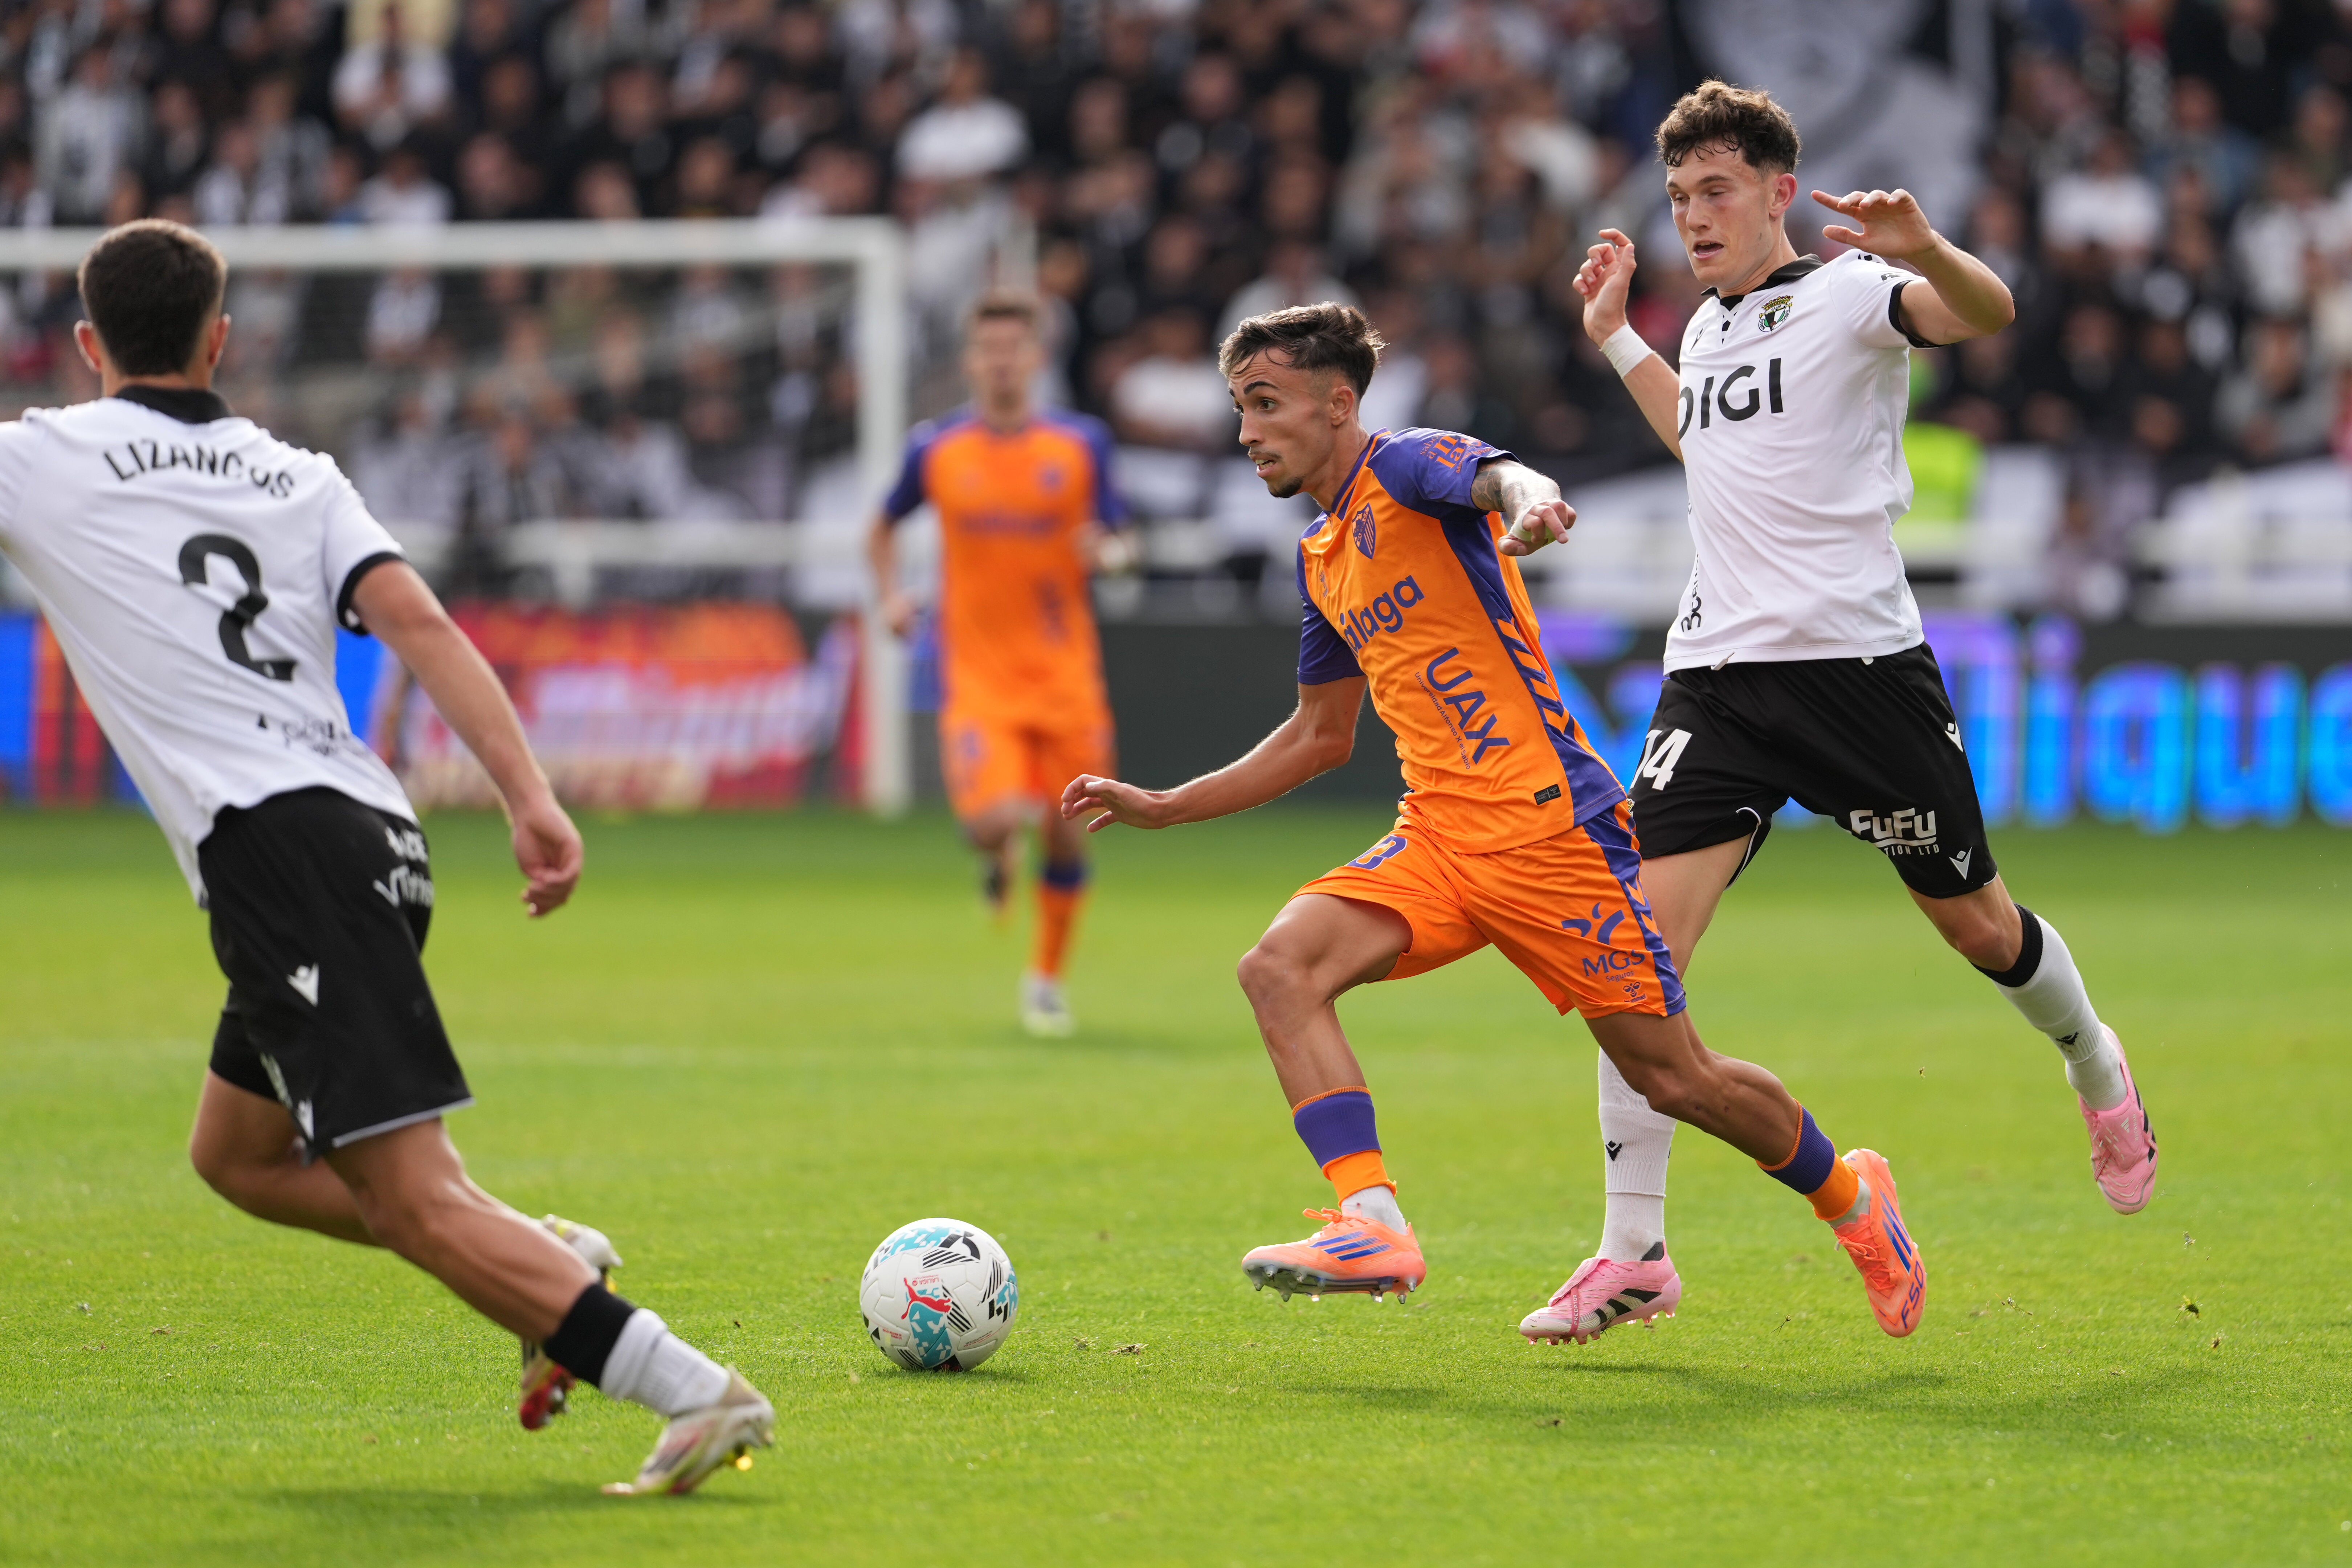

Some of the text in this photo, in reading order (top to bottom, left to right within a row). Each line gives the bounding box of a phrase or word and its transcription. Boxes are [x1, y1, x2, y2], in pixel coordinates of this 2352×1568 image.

[1420, 435, 1439, 456] sabo
[178, 534, 298, 681] 2
[1340, 575, 1425, 658] álaga
[1415, 671, 1442, 712] Universidad
[1440, 710, 1457, 736] Alfonso
[1461, 750, 1471, 769] Sabio
[1426, 647, 1511, 765] UAX
[1630, 728, 1692, 791] 14
[1918, 844, 1940, 855] LTD
[1581, 949, 1645, 976] MGS
[1606, 971, 1634, 983] Seguros
[1901, 1260, 1924, 1329] F50
